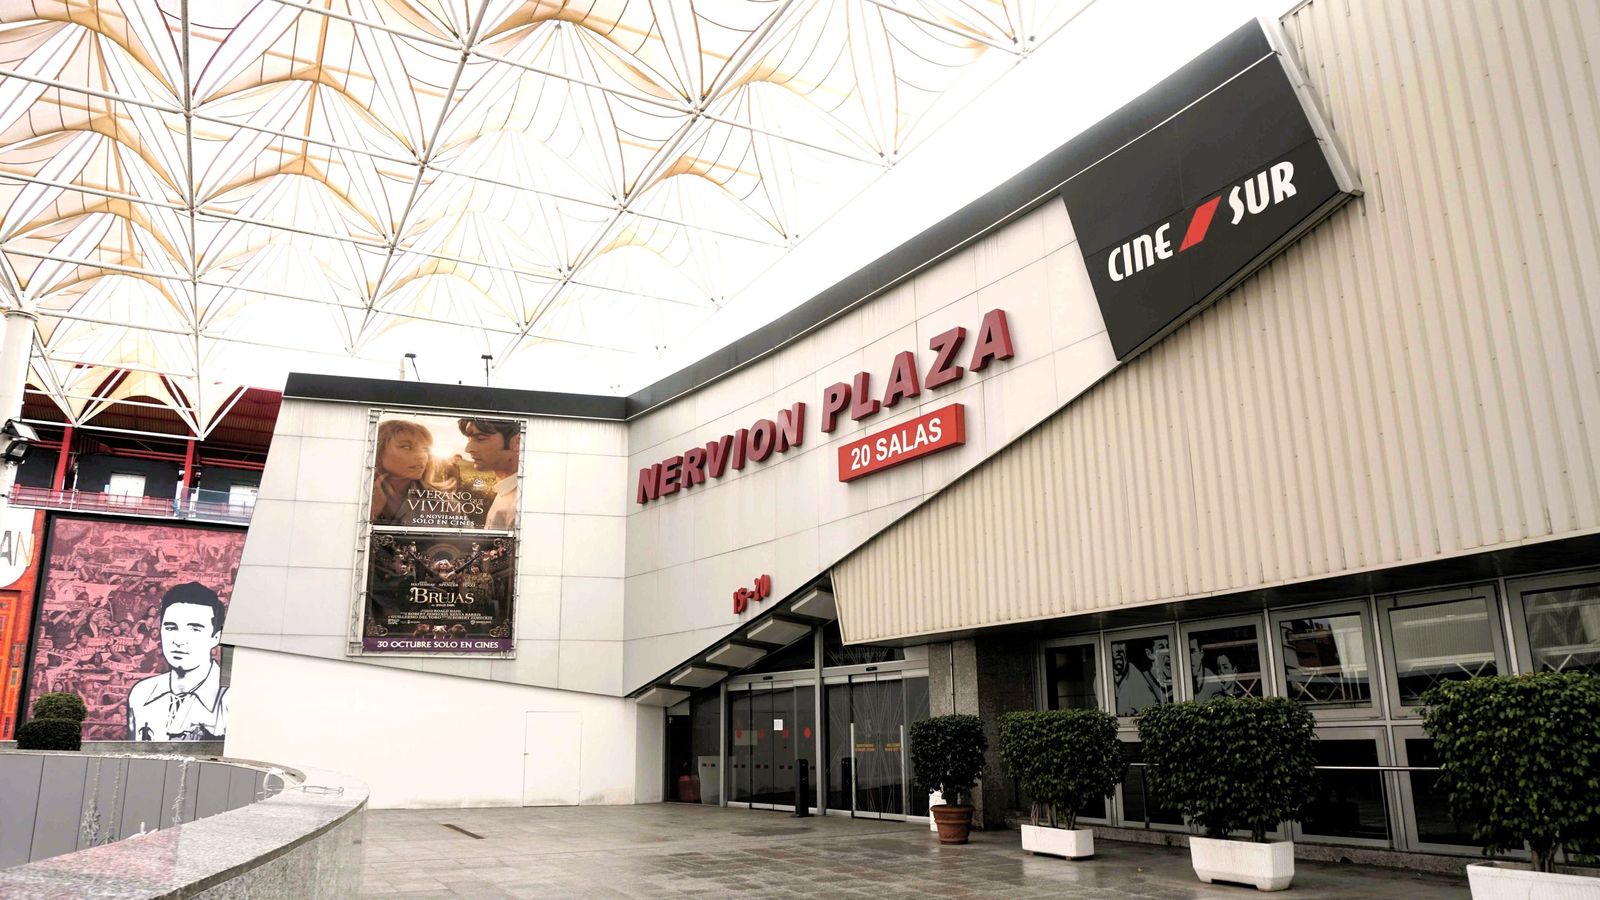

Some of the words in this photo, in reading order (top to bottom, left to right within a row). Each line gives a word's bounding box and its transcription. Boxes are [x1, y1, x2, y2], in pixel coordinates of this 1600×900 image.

[1228, 161, 1297, 225] SUR
[636, 402, 806, 505] NERVION
[821, 308, 1014, 433] PLAZA
[850, 445, 870, 471] 20
[875, 417, 942, 462] SALAS
[408, 499, 484, 514] VIVIMOS
[416, 489, 472, 500] VERANO
[732, 573, 772, 615] 15-20
[377, 640, 388, 648] 30
[390, 640, 432, 648] OCTUBRE
[433, 641, 458, 649] SOLO
[460, 641, 472, 649] EN
[474, 641, 499, 649] CINES
